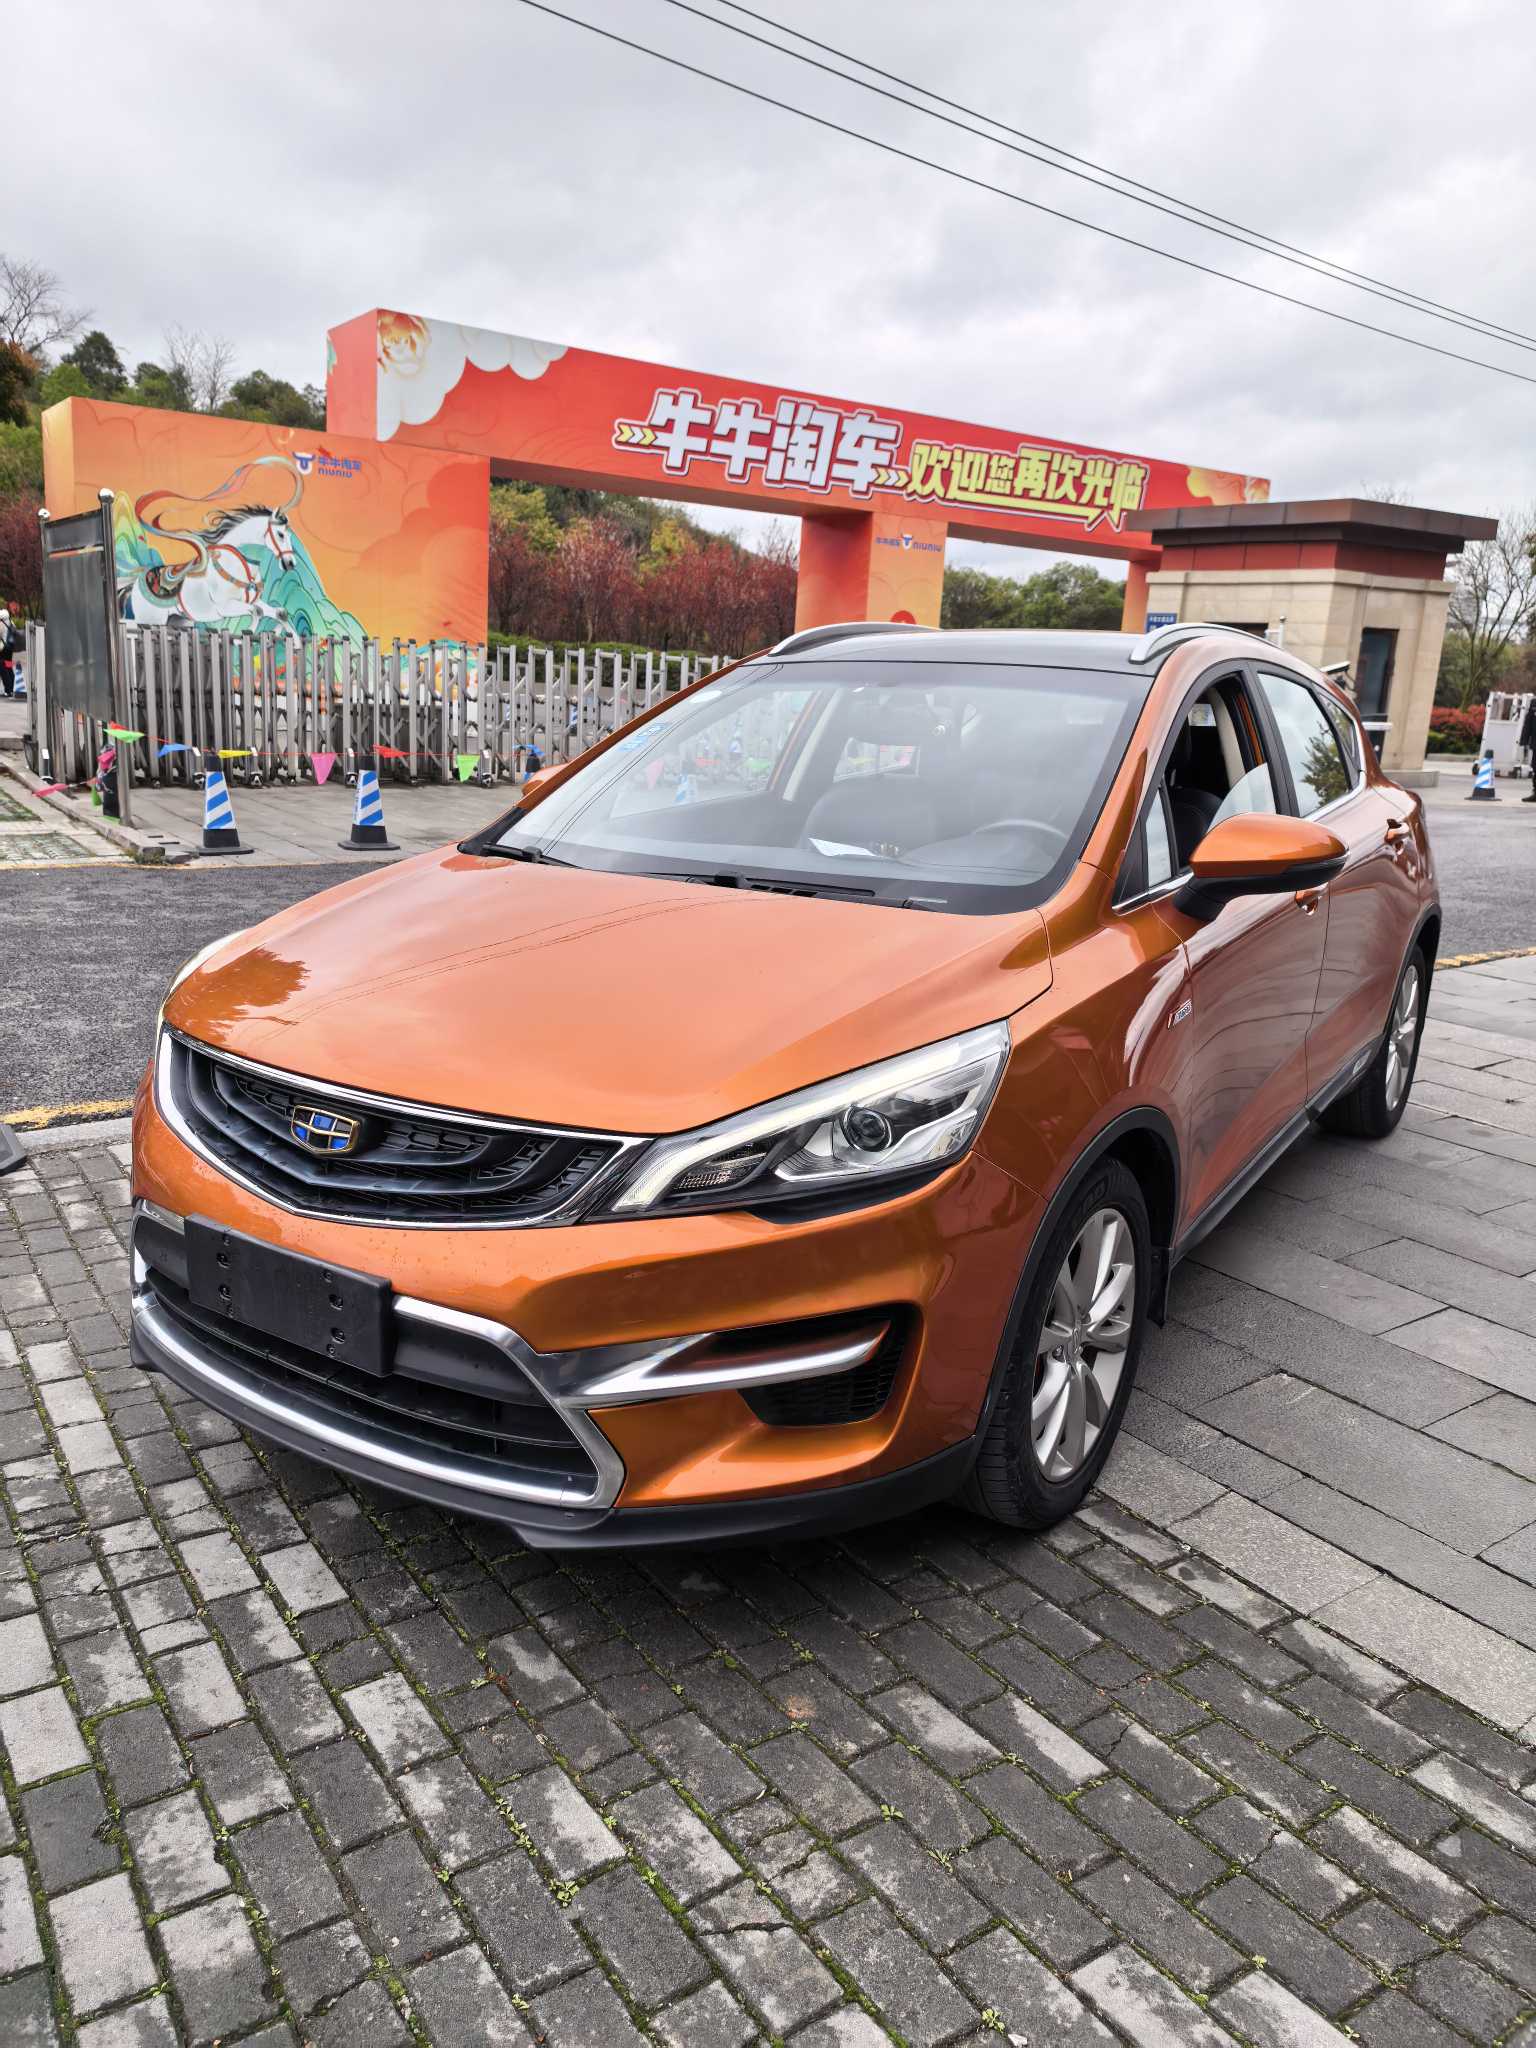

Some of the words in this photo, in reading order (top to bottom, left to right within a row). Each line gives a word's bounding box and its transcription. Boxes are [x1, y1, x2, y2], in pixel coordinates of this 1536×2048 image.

[650, 390, 898, 493] 牛牛淘车
[907, 444, 1146, 526] 欢迎您再次光临
